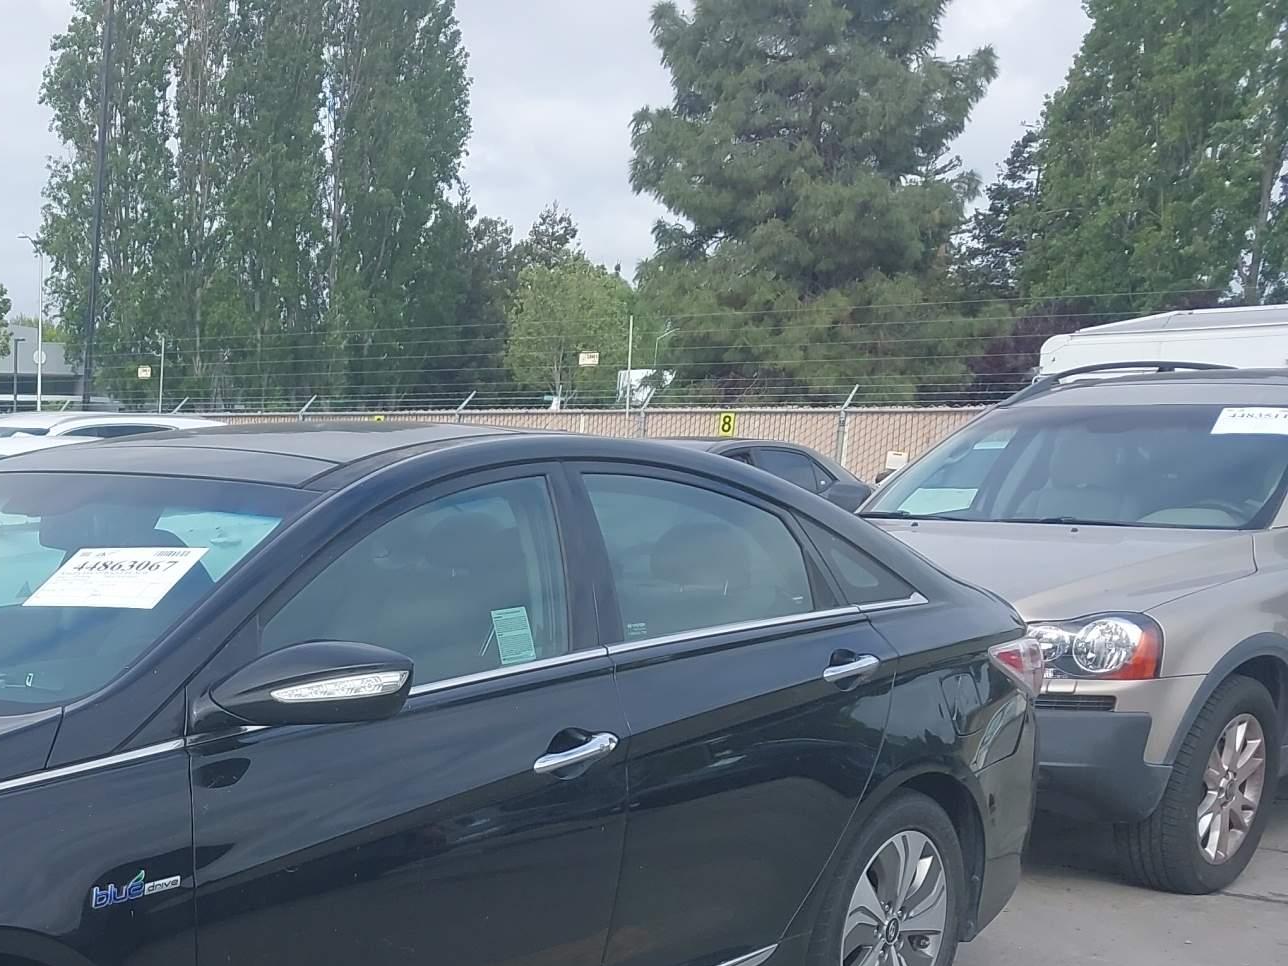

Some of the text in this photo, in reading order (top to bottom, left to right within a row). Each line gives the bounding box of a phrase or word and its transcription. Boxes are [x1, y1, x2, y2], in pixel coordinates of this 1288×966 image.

[722, 415, 731, 432] 8
[73, 560, 178, 572] 44863067
[92, 874, 144, 909] blue
